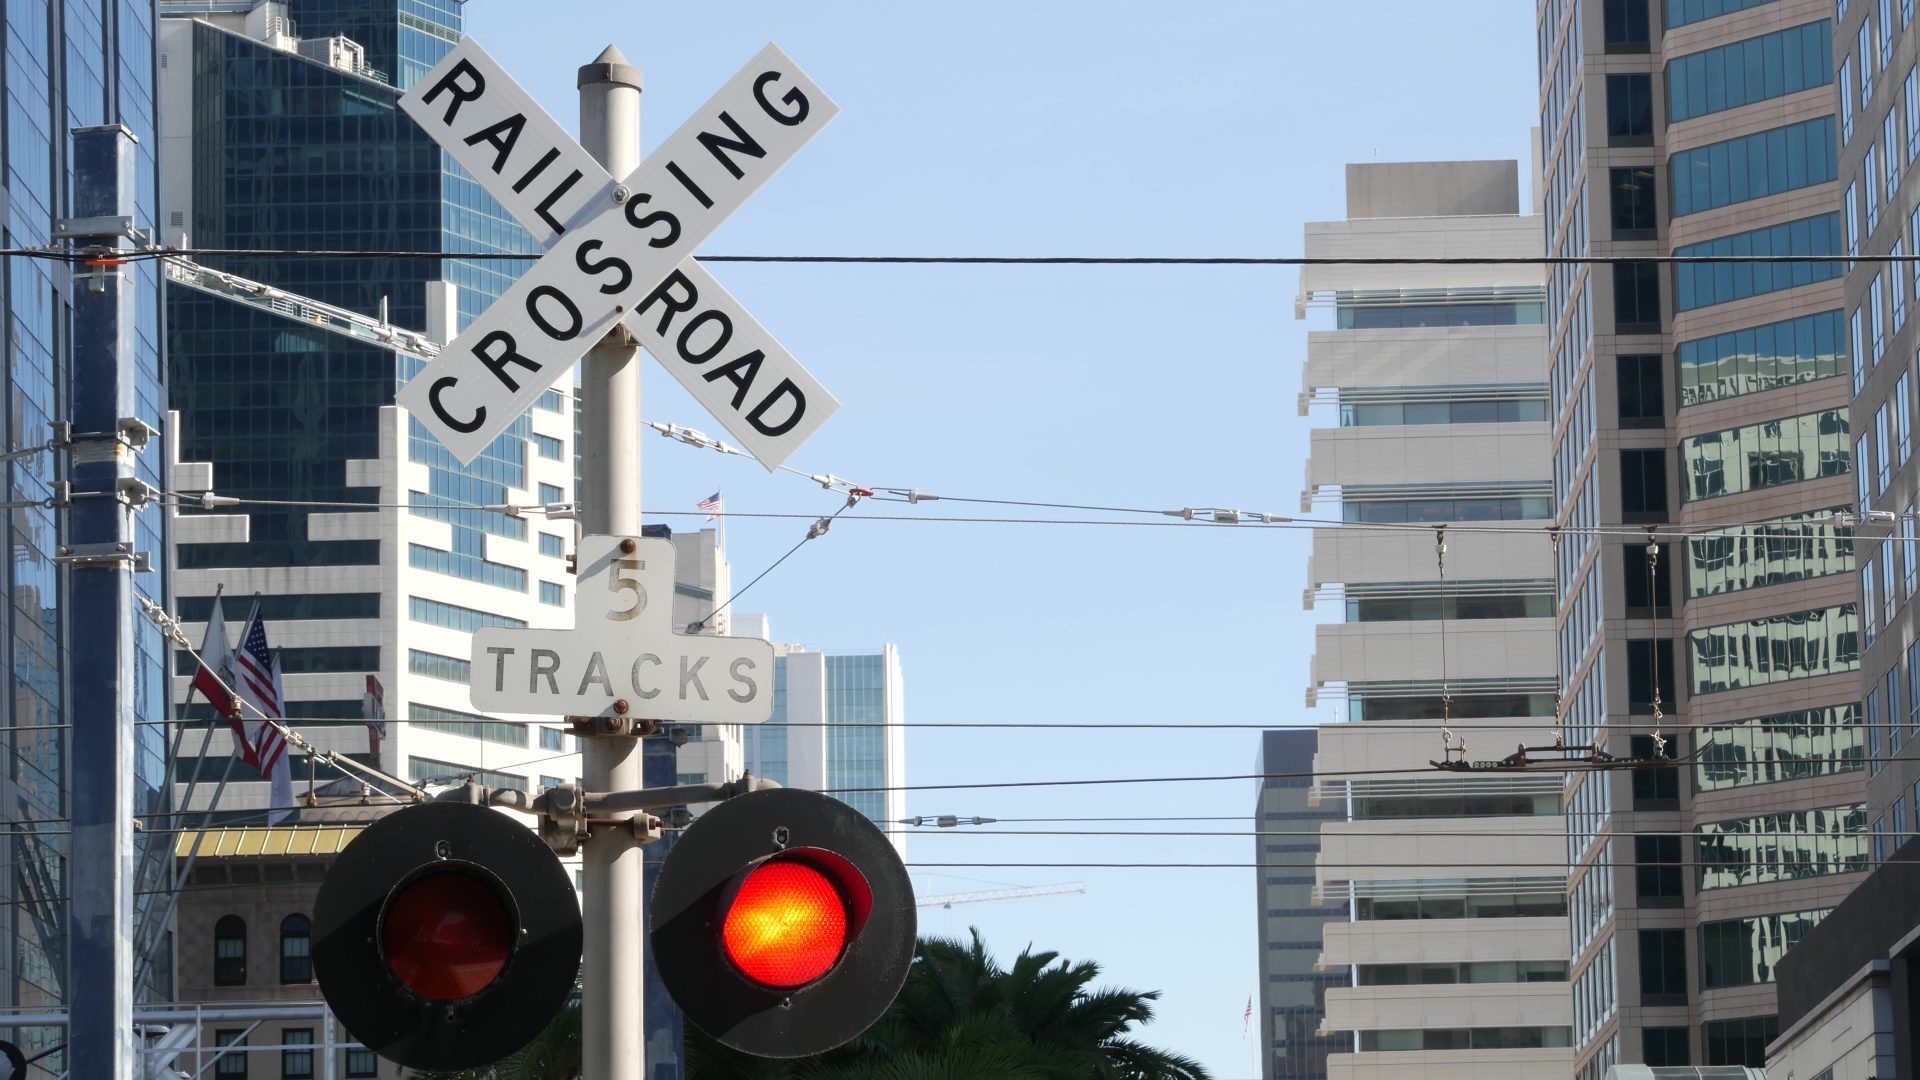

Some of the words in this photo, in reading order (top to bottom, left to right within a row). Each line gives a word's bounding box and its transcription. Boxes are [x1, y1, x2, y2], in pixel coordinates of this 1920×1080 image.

[421, 57, 584, 236] RAIL
[635, 268, 807, 437] ROAD
[428, 70, 810, 434] CROSSING
[486, 646, 758, 704] TRACKS
[605, 559, 648, 622] 5
